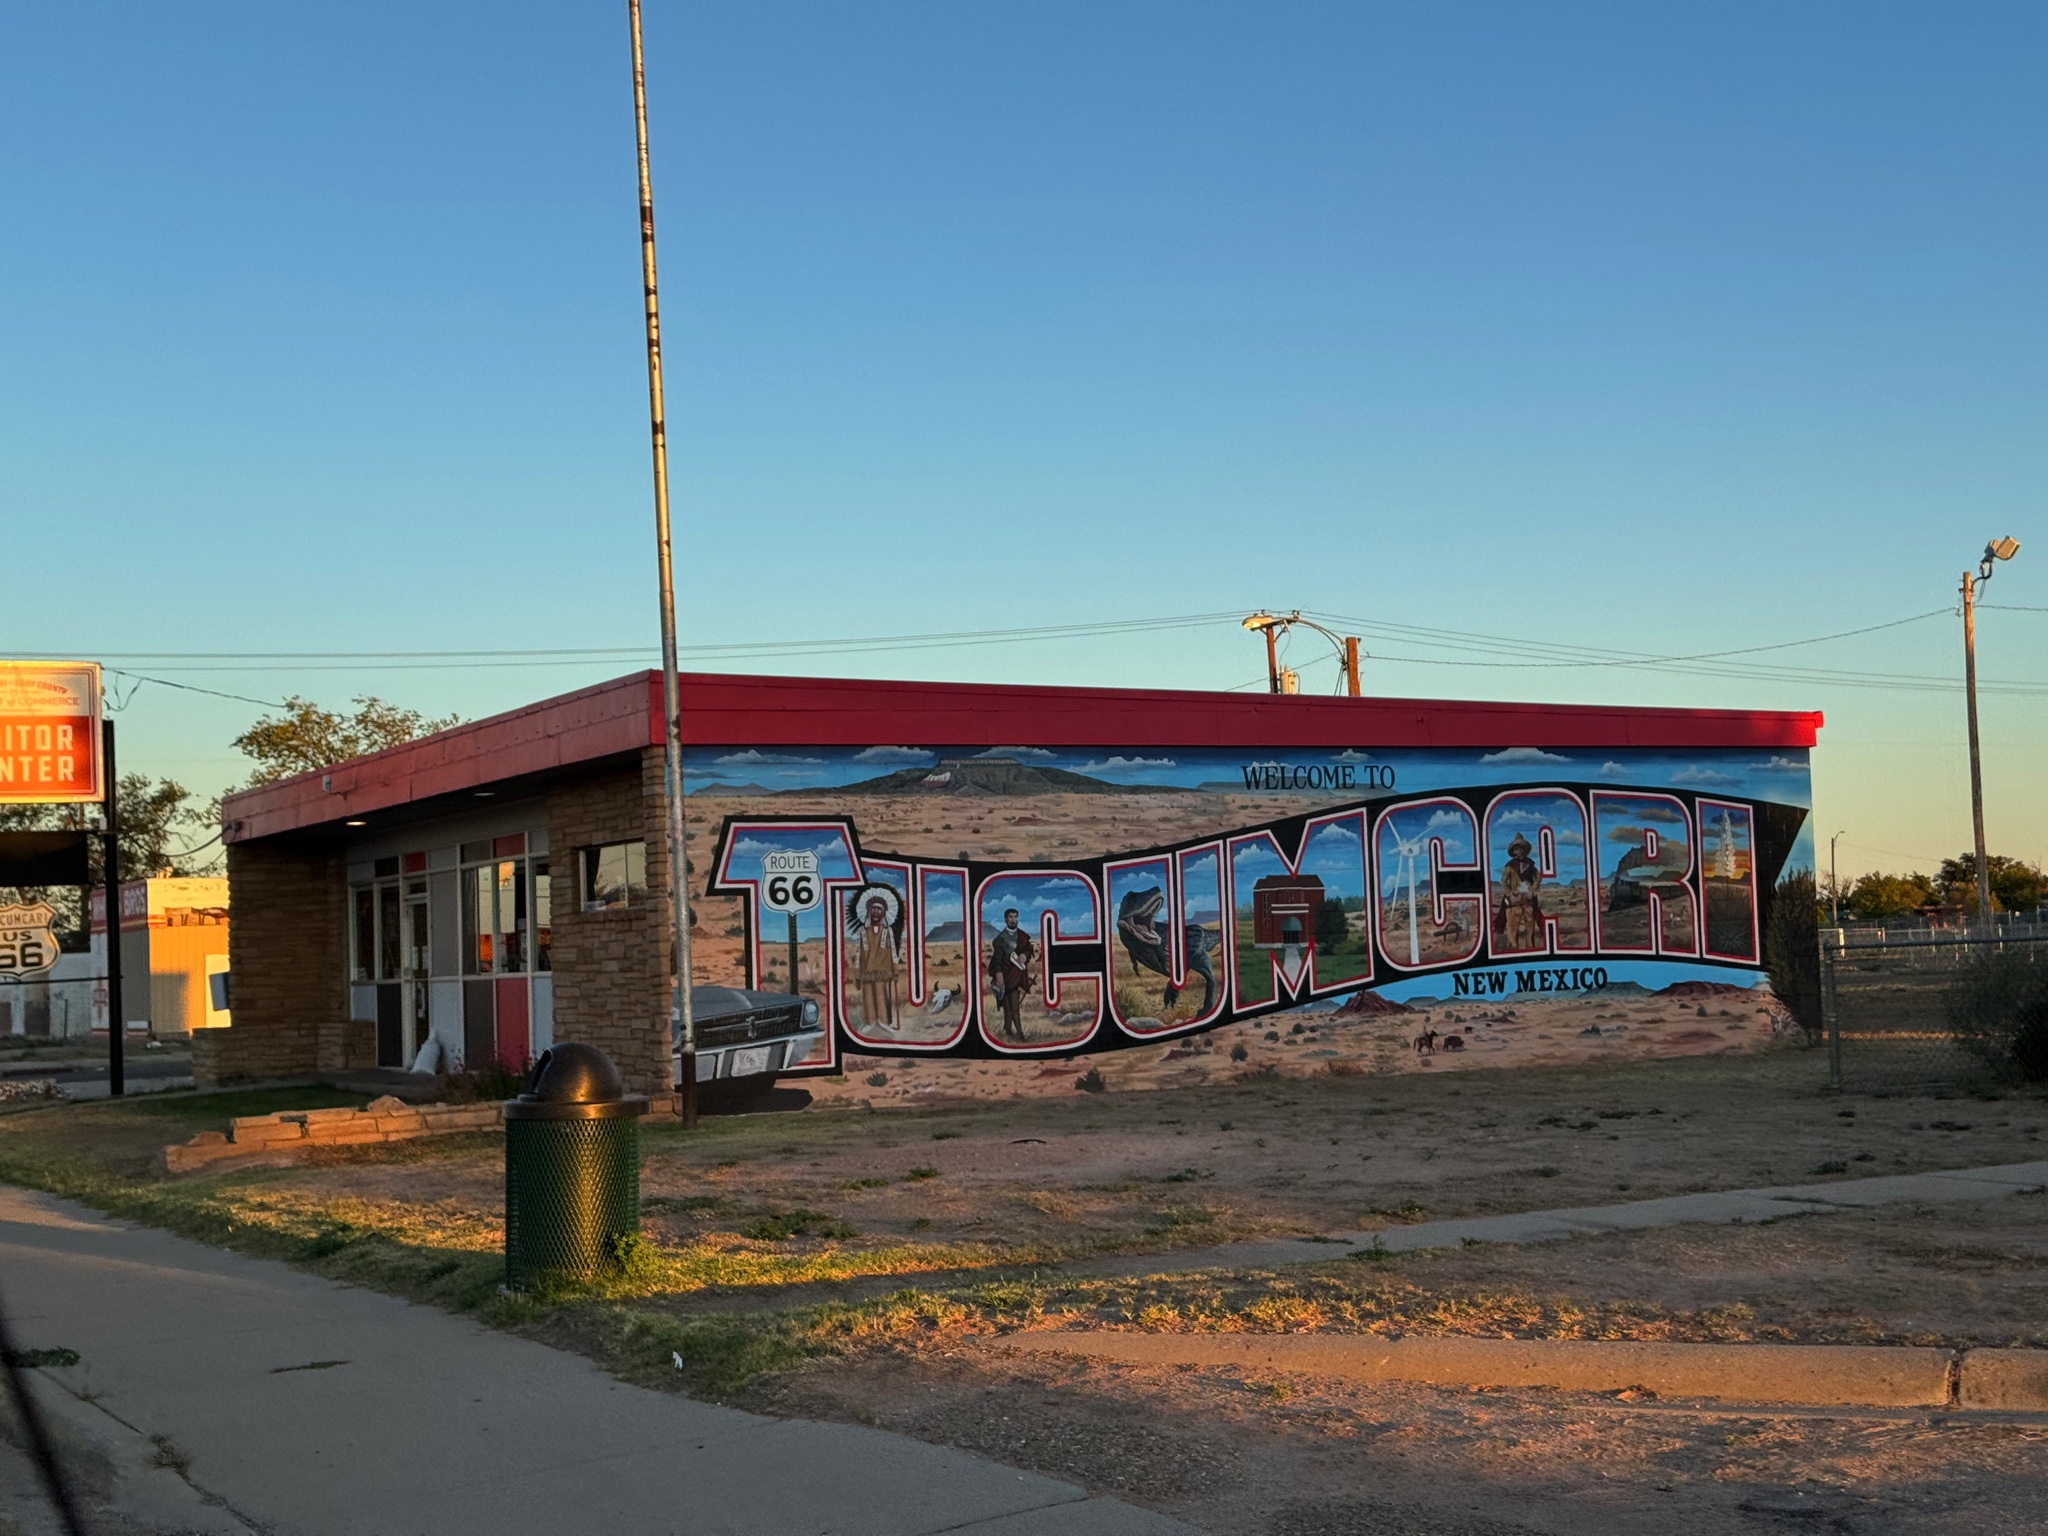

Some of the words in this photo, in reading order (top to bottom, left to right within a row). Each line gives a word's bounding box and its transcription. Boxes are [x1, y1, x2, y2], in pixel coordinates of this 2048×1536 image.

[1241, 765, 1355, 790] WELCOME
[1364, 765, 1395, 789] TO
[770, 856, 810, 869] ROUTE
[768, 875, 814, 906] 66
[2, 930, 33, 942] US
[712, 787, 1762, 1069] TUCUMCARI
[1452, 971, 1508, 996] NEW
[1515, 967, 1608, 993] MEXICO
